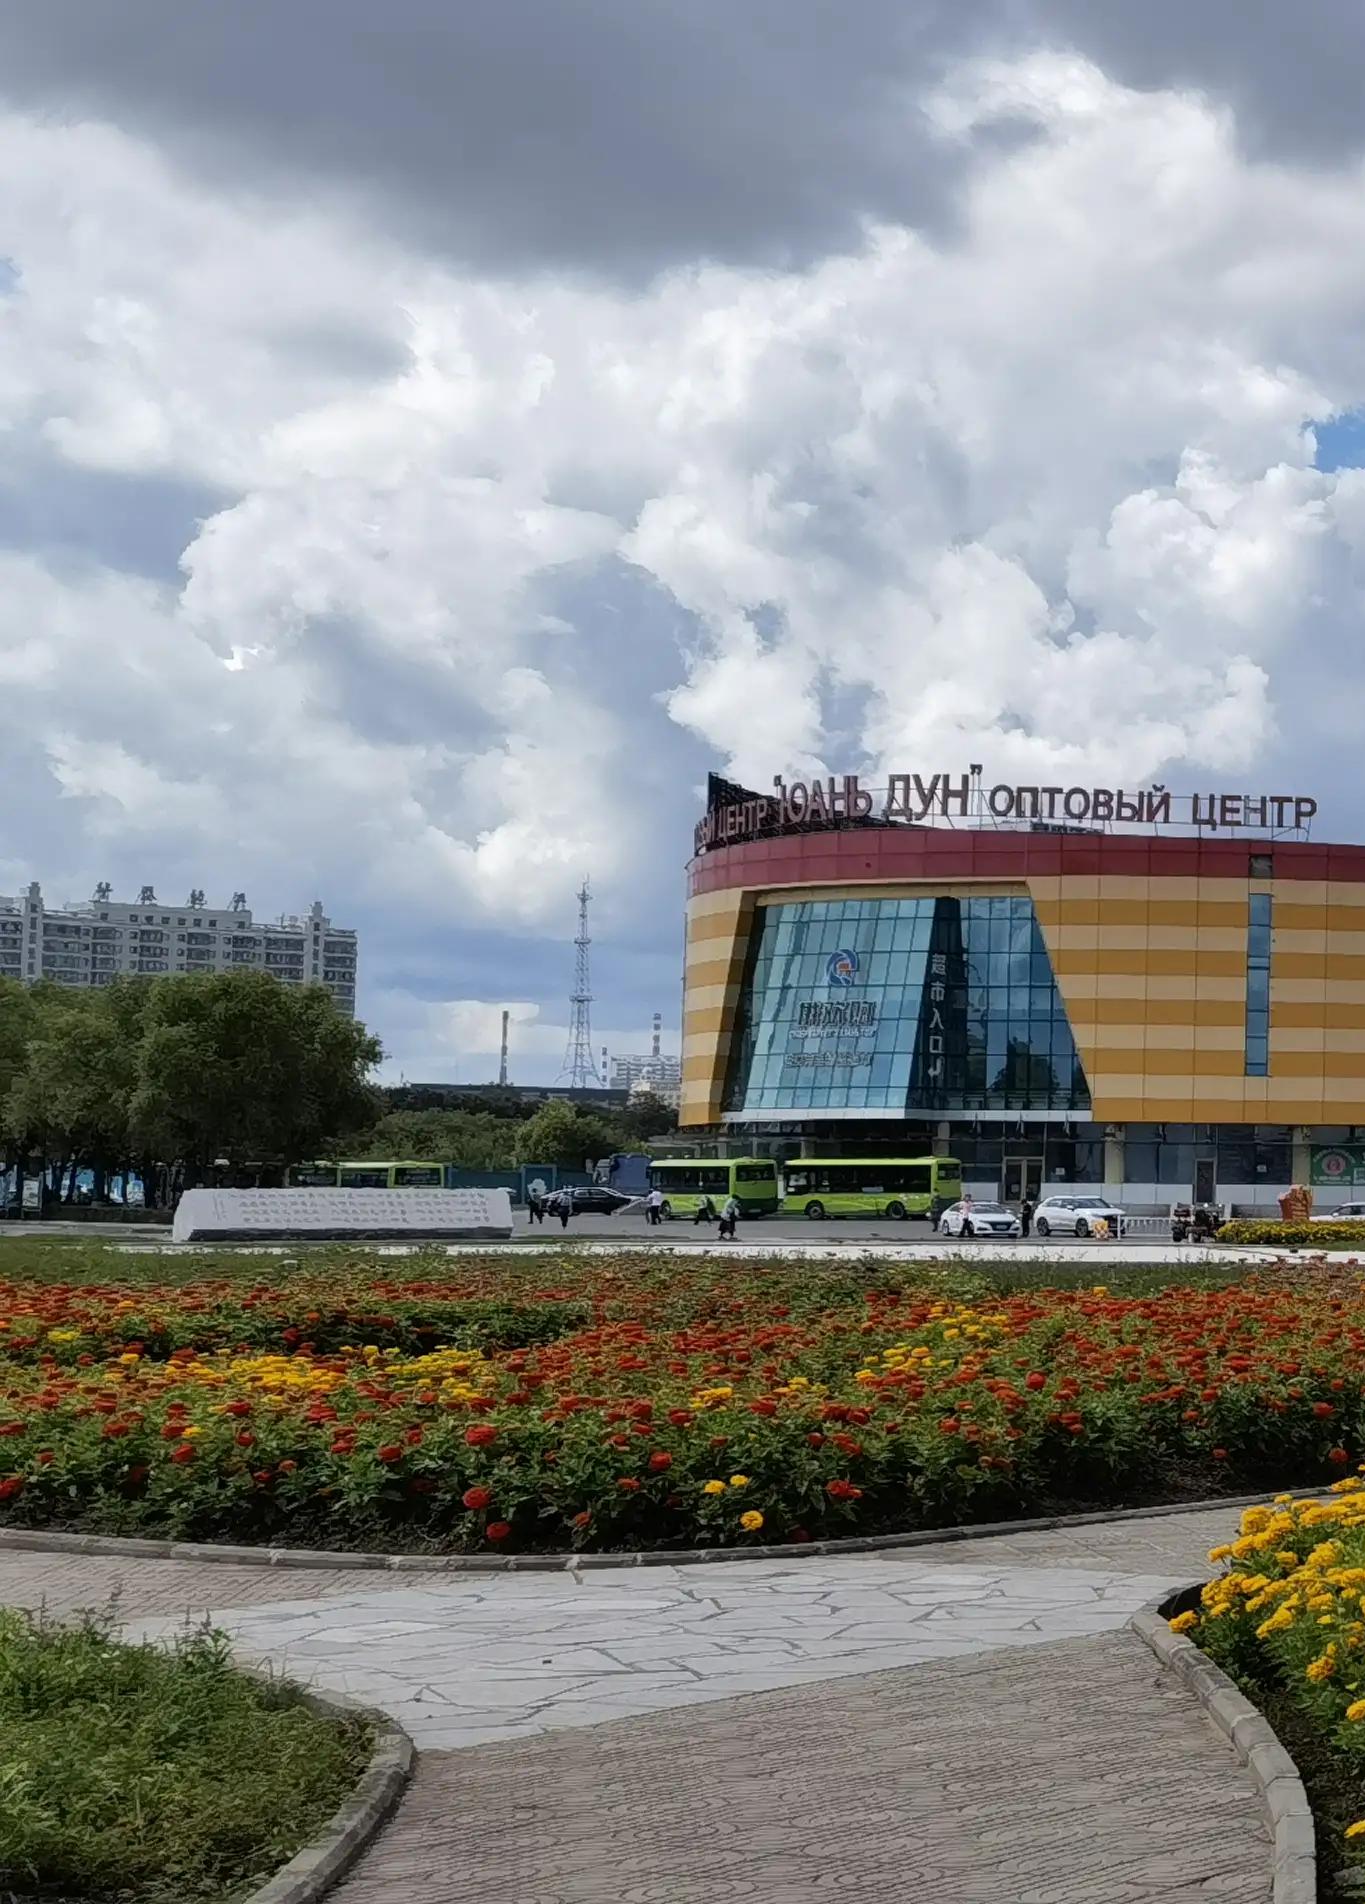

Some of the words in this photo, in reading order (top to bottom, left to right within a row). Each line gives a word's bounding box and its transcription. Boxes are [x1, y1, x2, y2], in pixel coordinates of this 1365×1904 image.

[989, 784, 1171, 824] ОПТОВЫЙ
[1192, 793, 1318, 831] ЦЕНТР
[928, 953, 947, 1055] 超市入口
